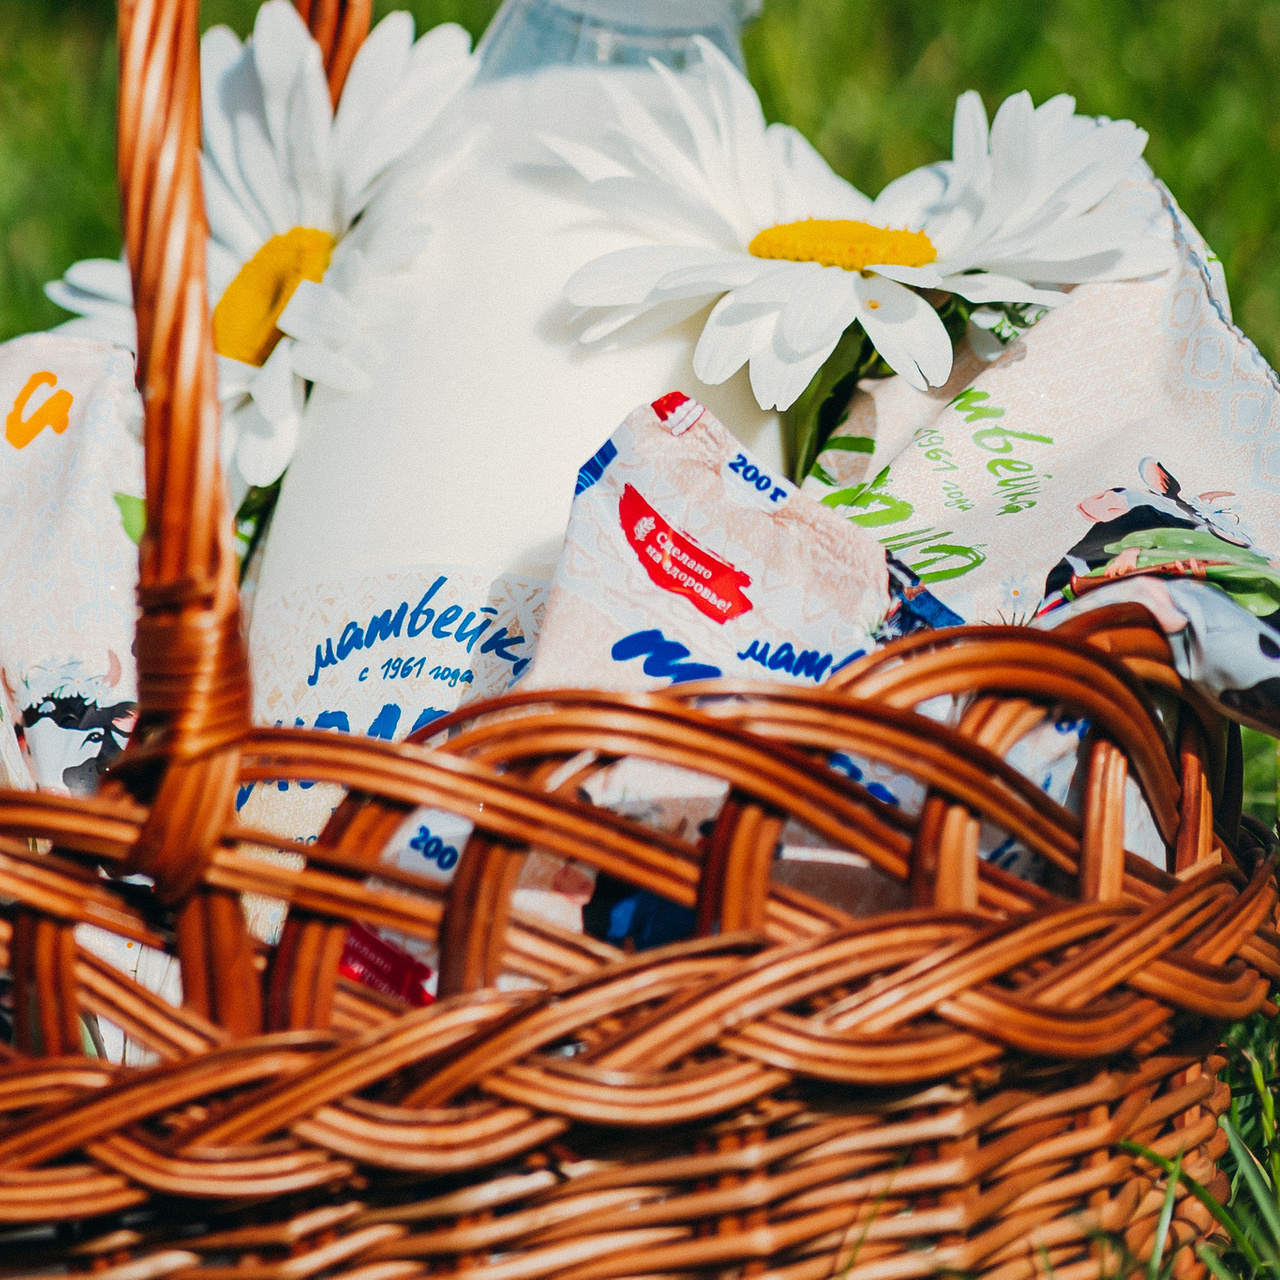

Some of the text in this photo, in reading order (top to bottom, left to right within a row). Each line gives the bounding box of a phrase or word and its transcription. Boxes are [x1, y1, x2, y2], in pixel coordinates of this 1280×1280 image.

[656, 531, 713, 580] Сделано
[381, 657, 426, 680] 1961
[429, 665, 474, 688] года
[408, 824, 459, 872] 200
